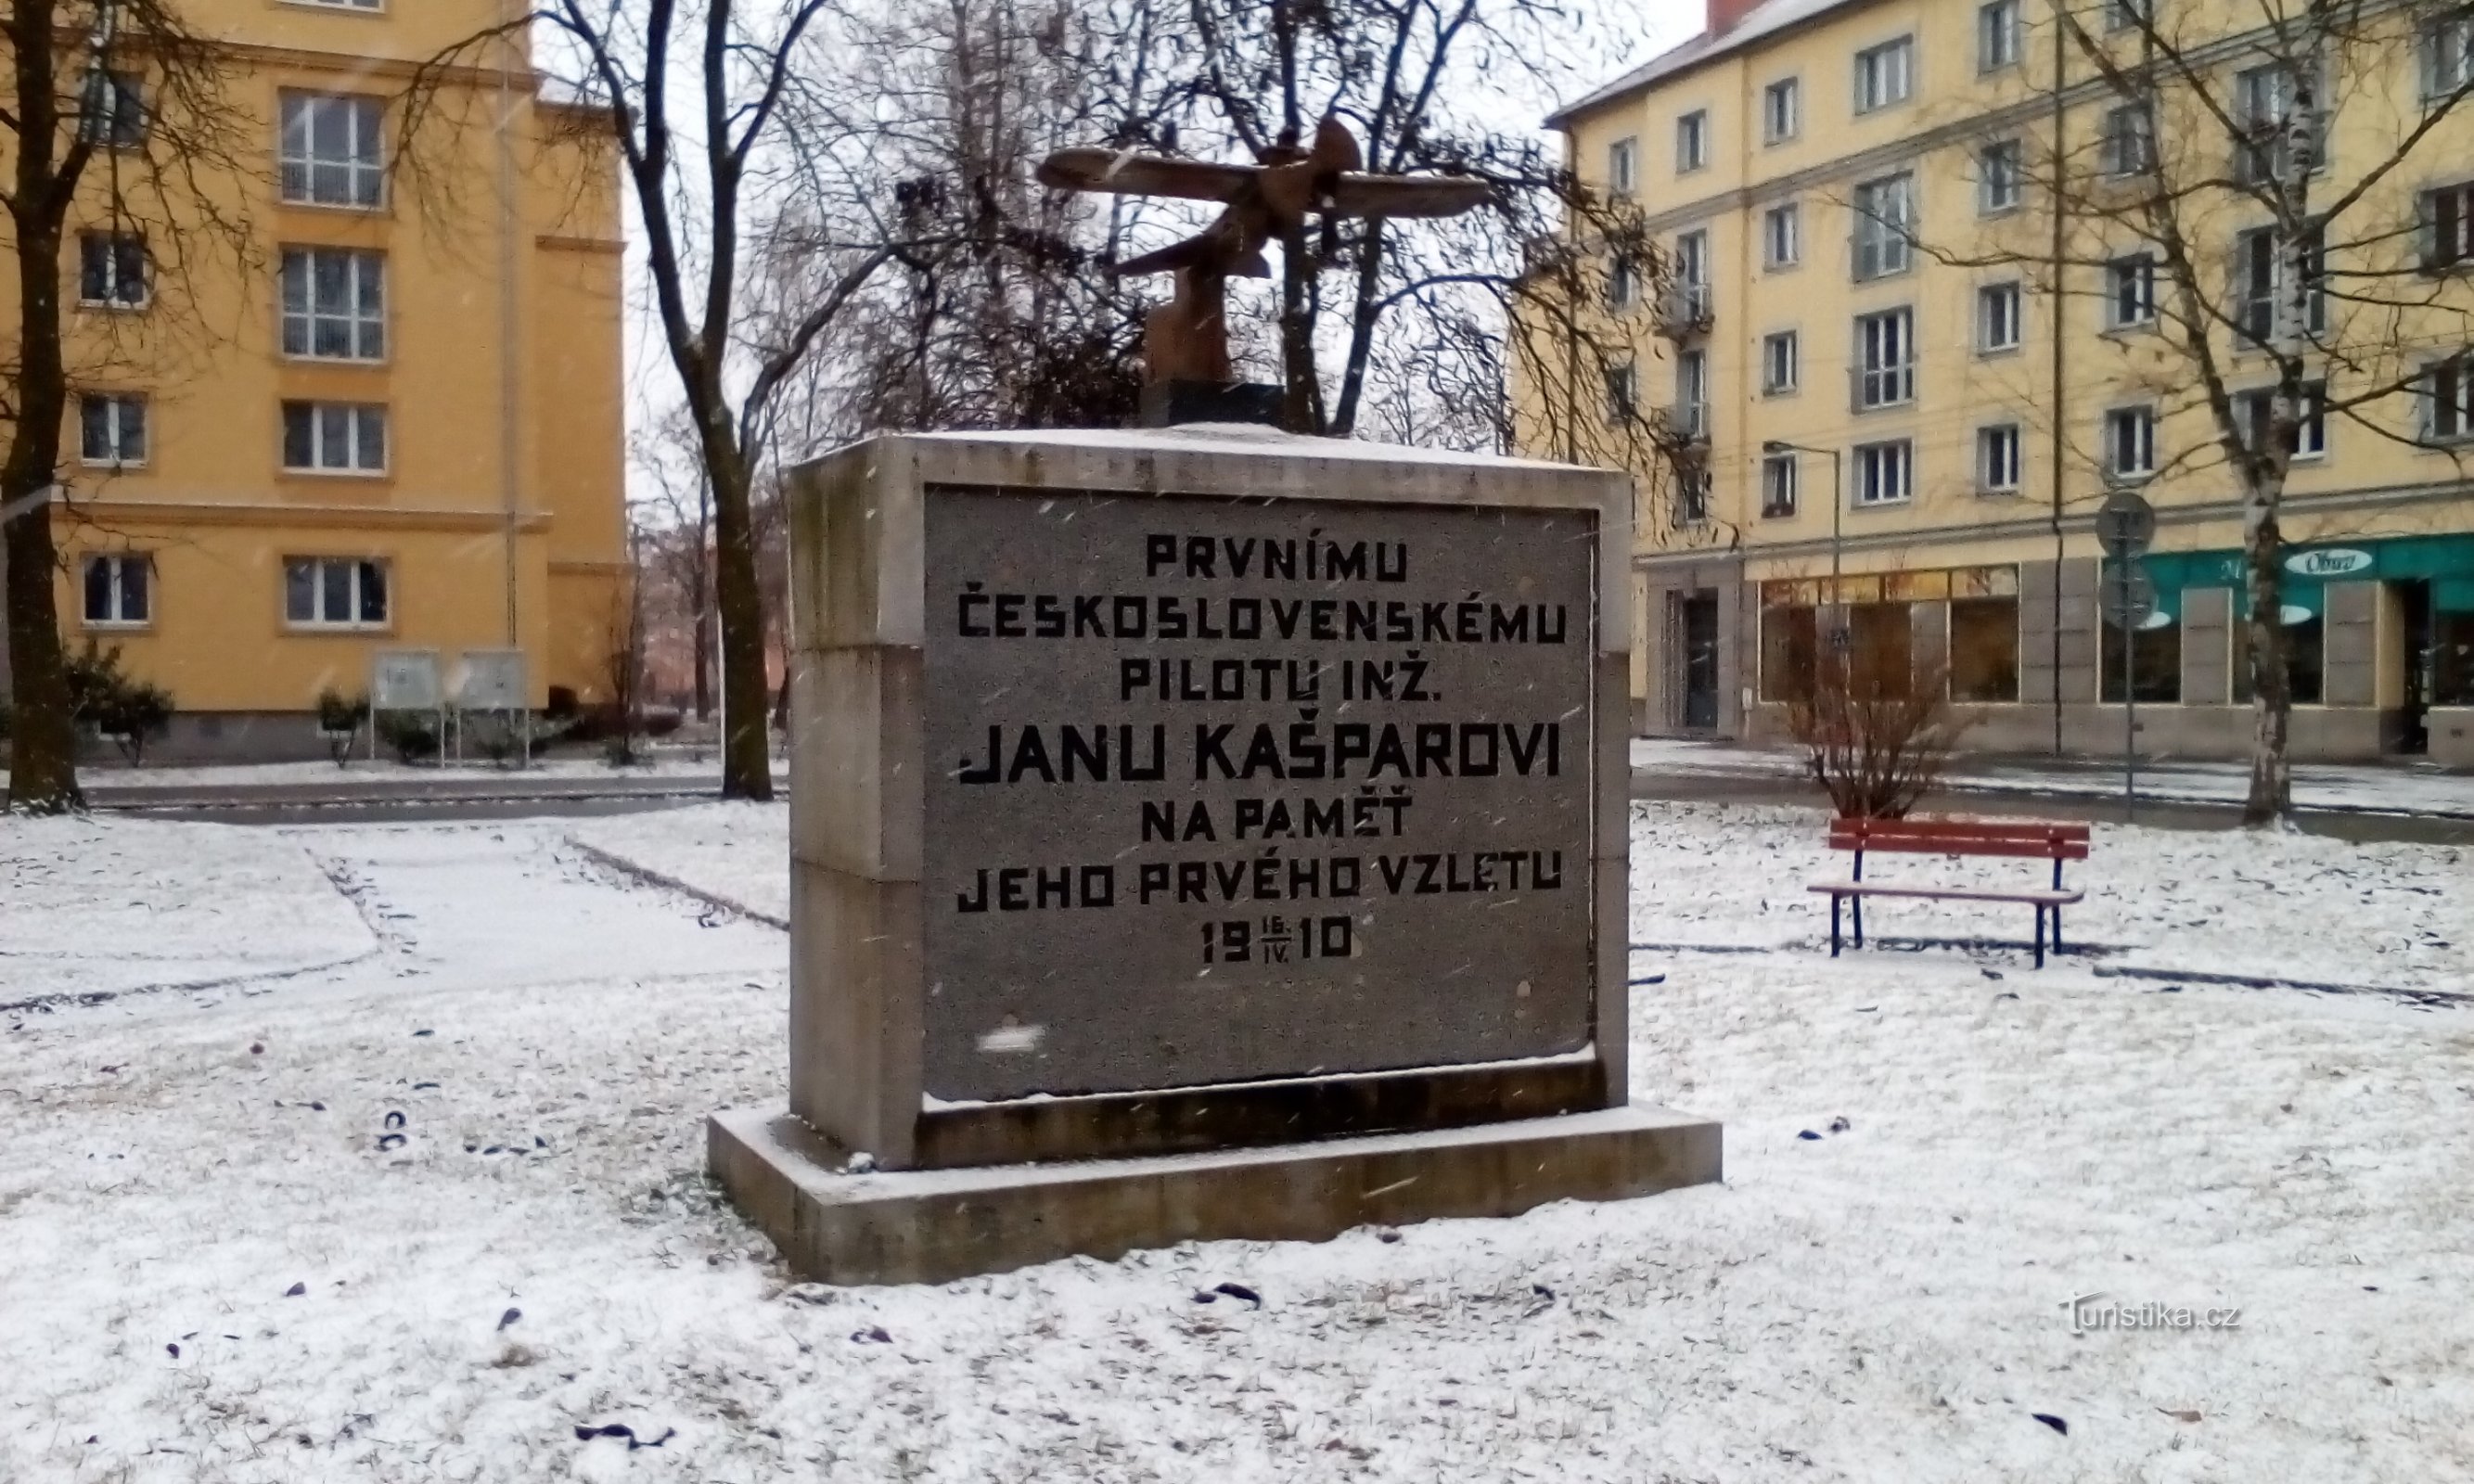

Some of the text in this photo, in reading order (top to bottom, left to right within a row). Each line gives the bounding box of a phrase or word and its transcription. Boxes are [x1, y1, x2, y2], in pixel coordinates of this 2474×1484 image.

[1147, 528, 1406, 582] PRVNÍMU
[958, 582, 1567, 643] ČESKOSLOVENSKÉMU
[1121, 650, 1441, 701] PILOTU INŽ.
[959, 708, 1560, 784] JANU KAŠPAROVI
[1142, 785, 1413, 842] NA PAMĚŤ
[957, 846, 1562, 913] JEHO PRVÉHO VZLETU
[1201, 921, 1250, 964] 19
[1301, 915, 1352, 958] 10
